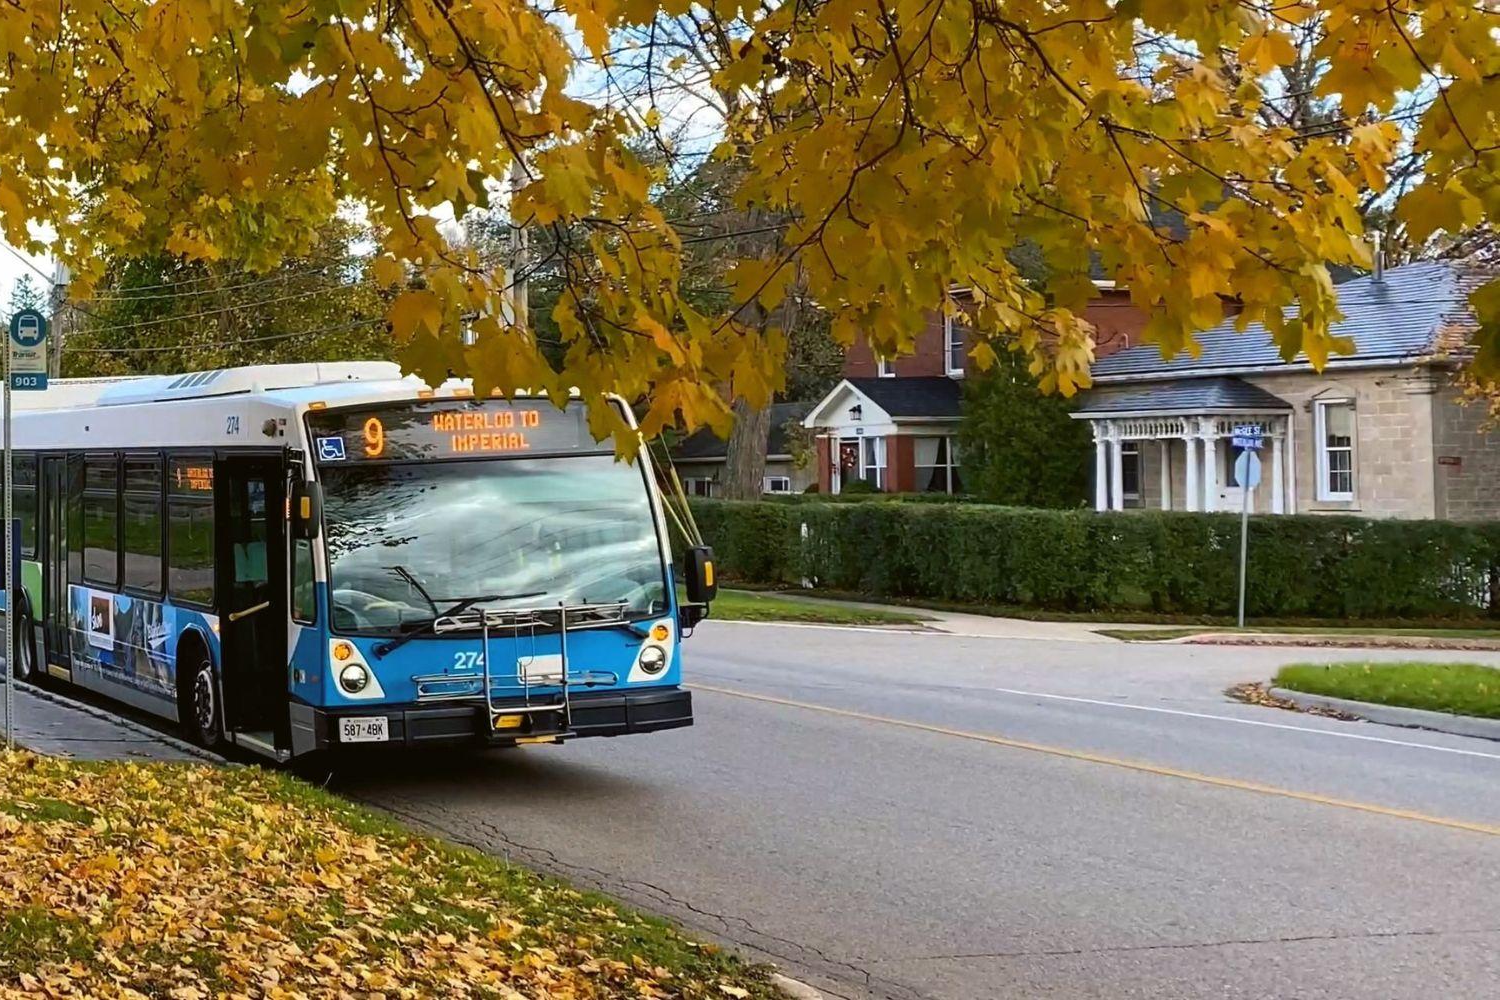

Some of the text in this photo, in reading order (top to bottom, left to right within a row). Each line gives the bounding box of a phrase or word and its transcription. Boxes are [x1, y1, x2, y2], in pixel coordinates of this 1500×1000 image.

[15, 376, 37, 387] 903
[226, 415, 240, 435] 274
[433, 410, 540, 431] WATERLOO TO
[364, 417, 383, 457] 9
[452, 432, 530, 452] IMPERIAL
[344, 724, 361, 737] 587
